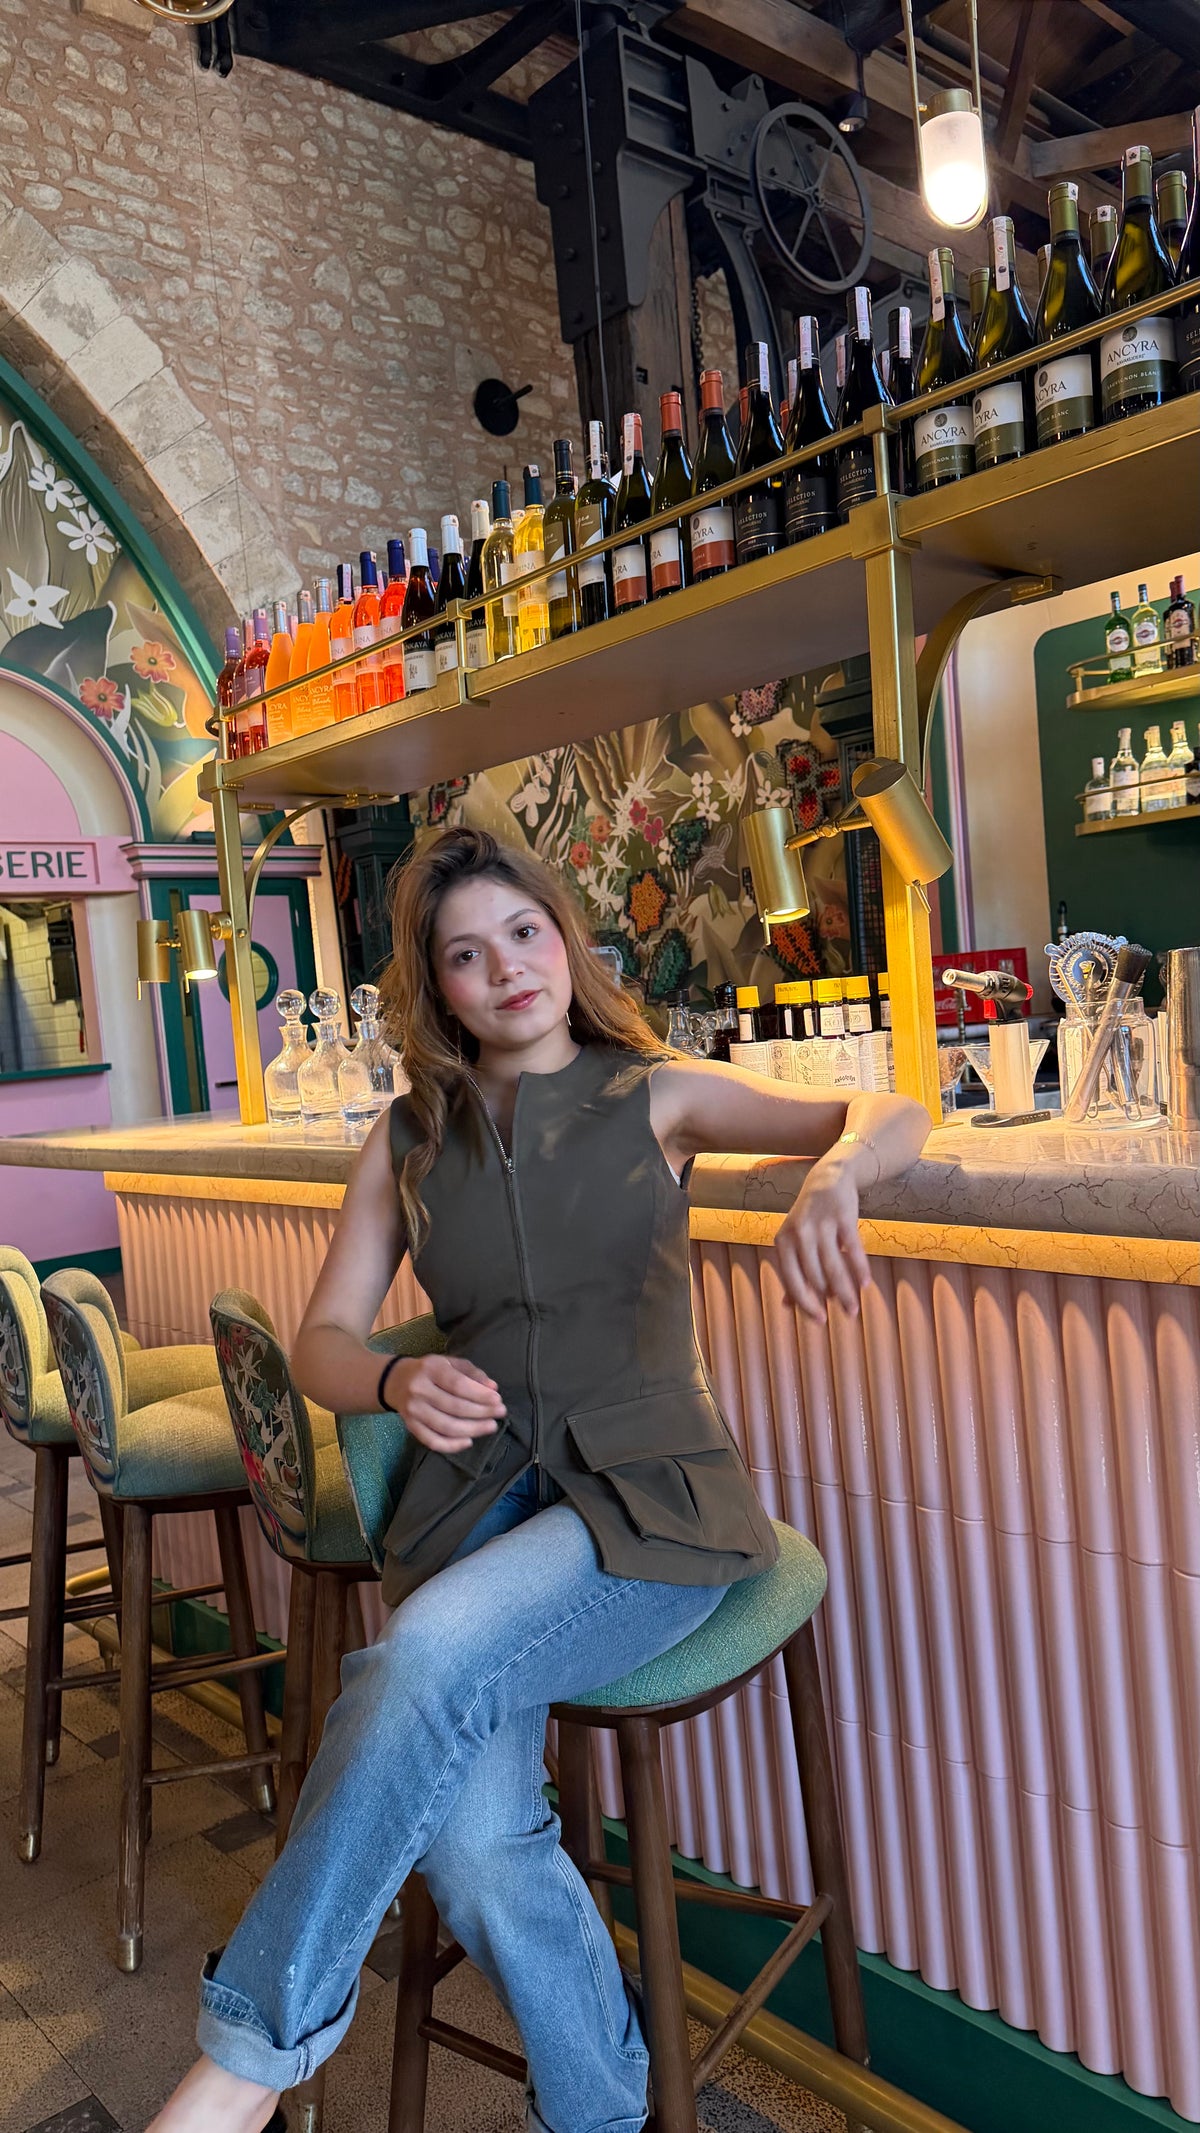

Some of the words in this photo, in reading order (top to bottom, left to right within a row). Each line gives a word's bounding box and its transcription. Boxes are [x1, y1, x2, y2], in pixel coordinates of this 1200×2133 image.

[1107, 340, 1159, 365] ANCYRA
[1036, 380, 1067, 403] NCYRA
[974, 408, 999, 427] CYRA
[921, 426, 967, 446] ANCYRA
[693, 526, 715, 541] CYRA
[269, 702, 288, 711] CYRA
[0, 850, 88, 879] ERIE
